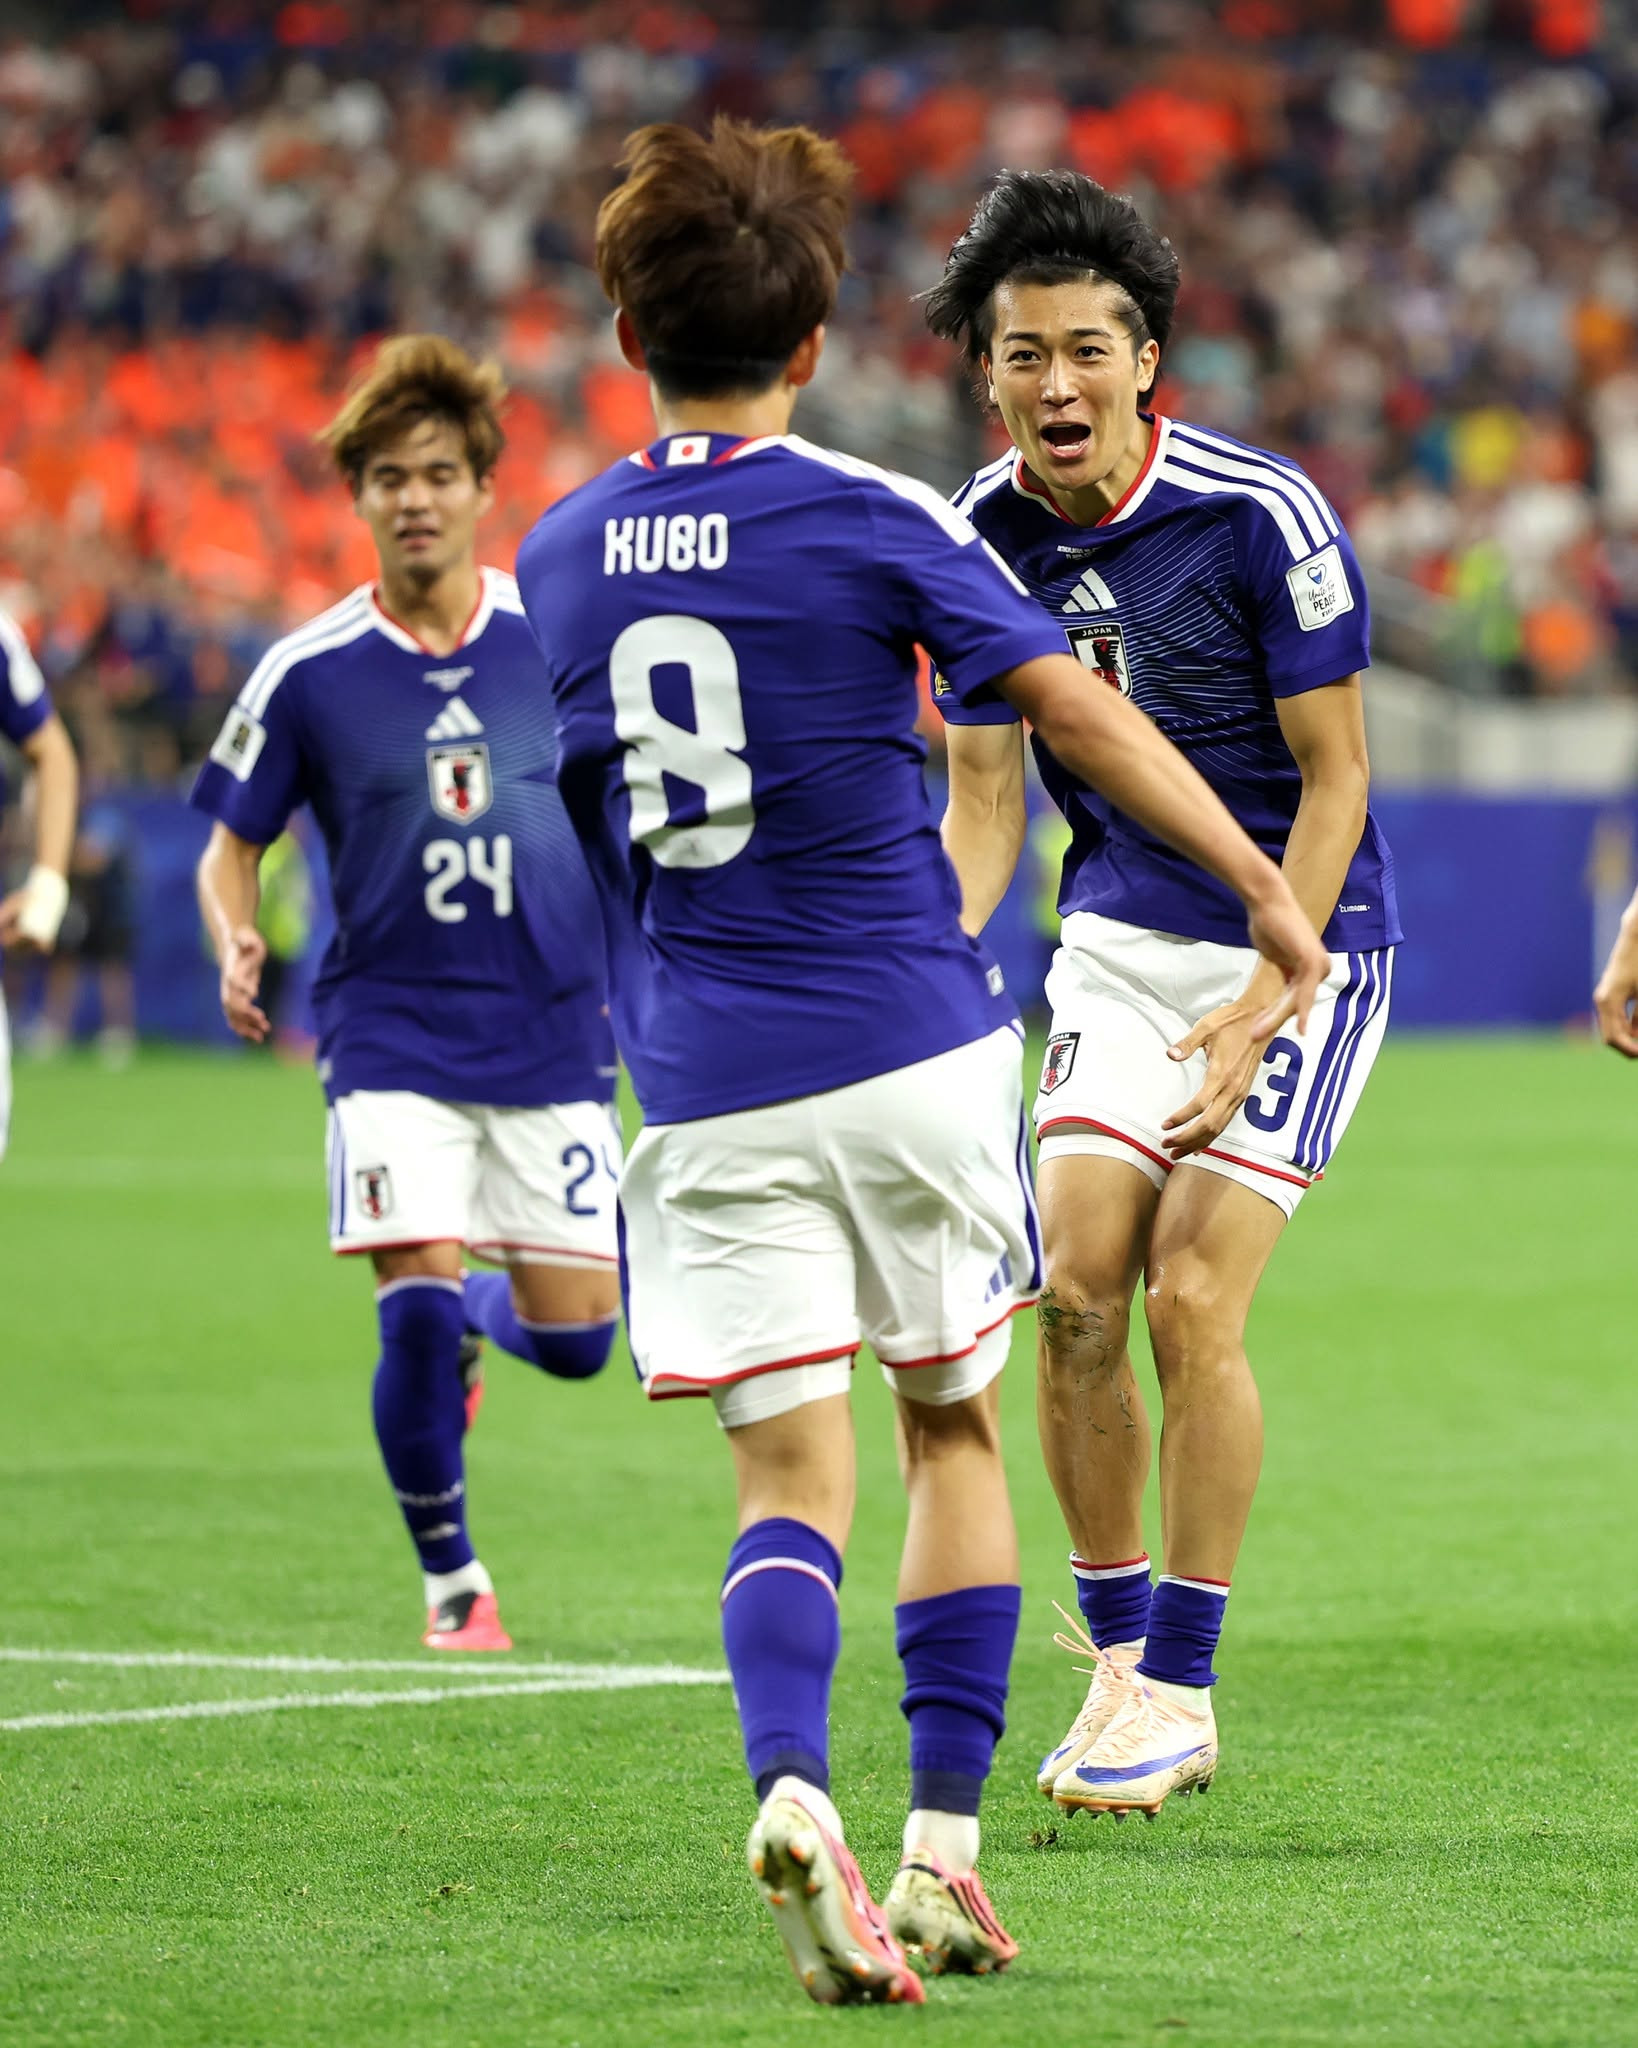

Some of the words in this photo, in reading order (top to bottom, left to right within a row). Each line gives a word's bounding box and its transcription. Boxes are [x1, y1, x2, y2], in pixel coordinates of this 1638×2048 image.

[604, 513, 728, 576] KUBO
[1082, 627, 1112, 637] JAPAN
[1313, 591, 1336, 612] PEACE
[609, 614, 756, 869] 8
[422, 833, 513, 924] 24
